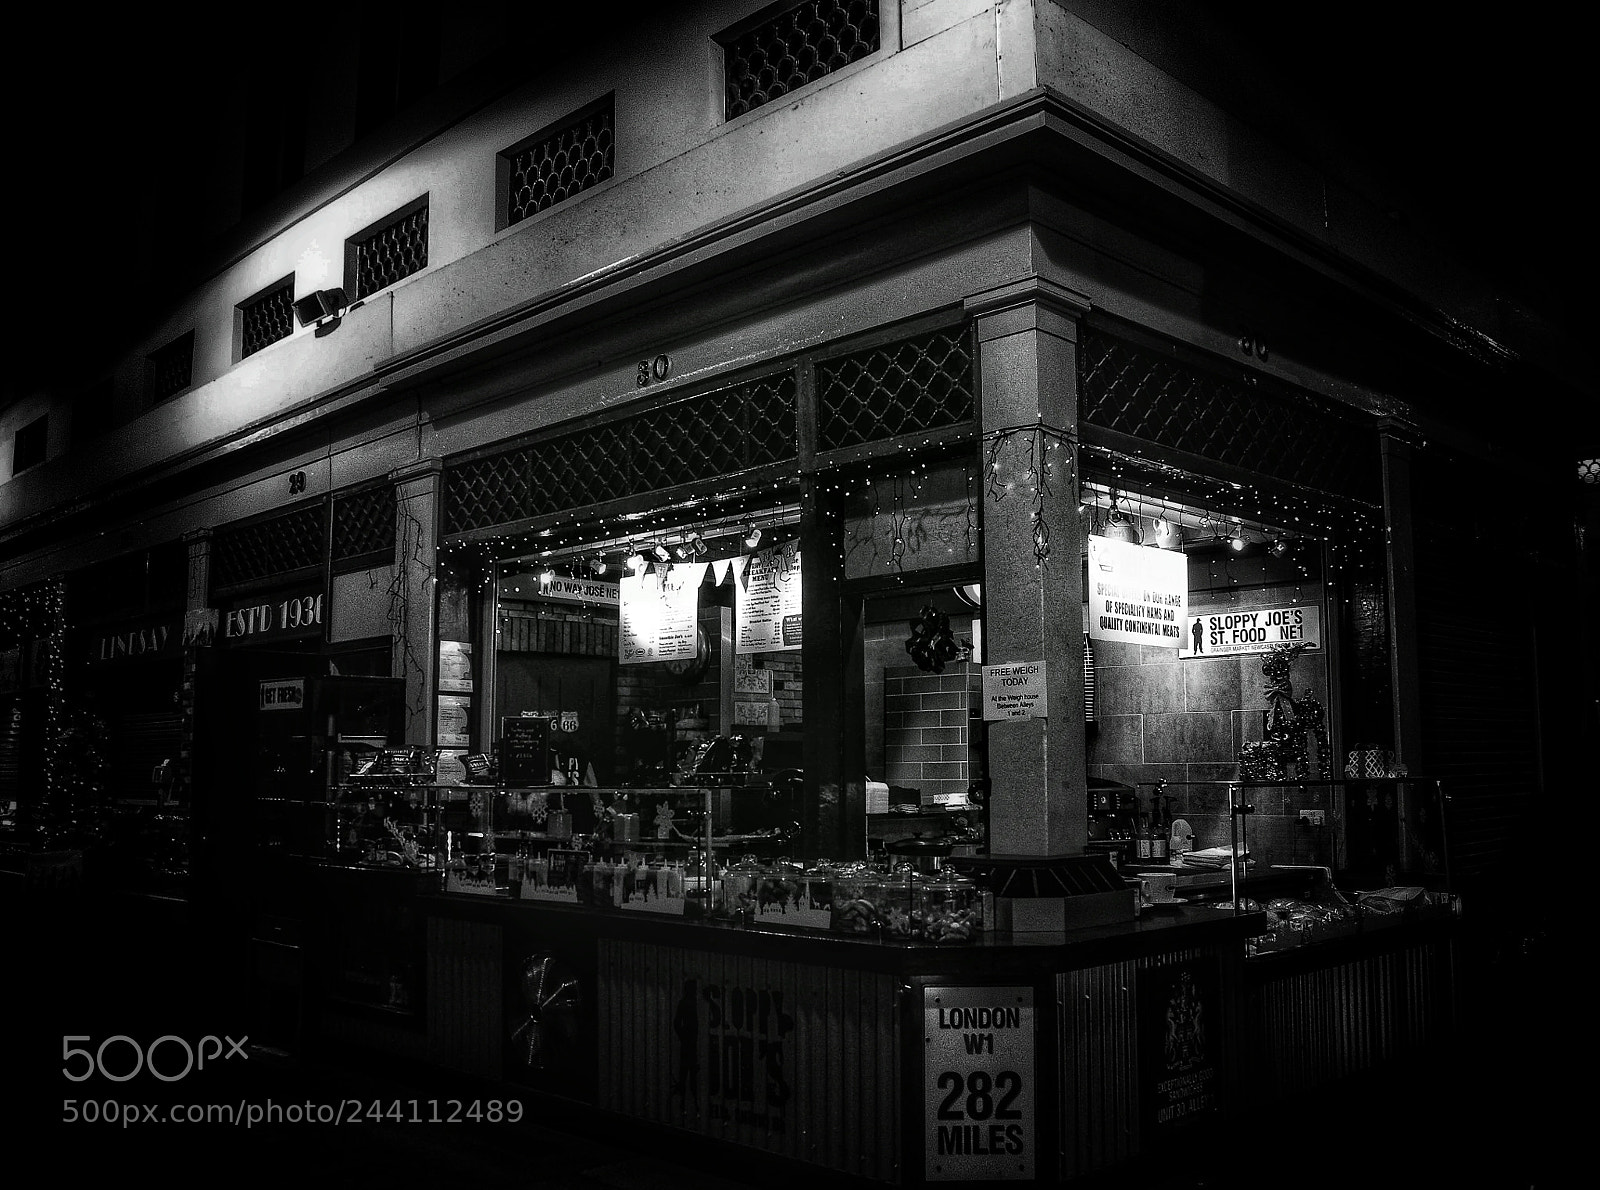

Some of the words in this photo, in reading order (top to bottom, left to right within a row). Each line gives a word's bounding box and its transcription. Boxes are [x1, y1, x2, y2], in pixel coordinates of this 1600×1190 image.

[637, 354, 669, 386] 30
[550, 580, 562, 592] NO
[1105, 599, 1113, 614] OF
[1114, 601, 1146, 618] SPECIALITY
[1146, 606, 1162, 621] HAMS
[1163, 608, 1175, 622] AND
[1209, 613, 1259, 632] SLOPPY
[1264, 609, 1303, 627] JOE'S
[1099, 616, 1124, 631] QUALITY
[1124, 619, 1161, 636] CONTINENTAL
[1162, 623, 1180, 639] MEATS
[1209, 631, 1229, 646] ST.
[1232, 627, 1267, 644] FOOD
[1279, 625, 1304, 641] NE1
[990, 667, 1011, 677] FREE
[1012, 665, 1039, 675] WEIGH
[1001, 677, 1029, 687] TODAY
[1019, 701, 1034, 709] Alleys
[563, 720, 577, 731] 66
[939, 1007, 1020, 1029] LONDON
[963, 1033, 994, 1055] W1
[937, 1070, 1022, 1121] 282
[1157, 1105, 1174, 1123] UNIT
[1188, 1093, 1209, 1112] ALLEY
[937, 1124, 1024, 1155] MILES
